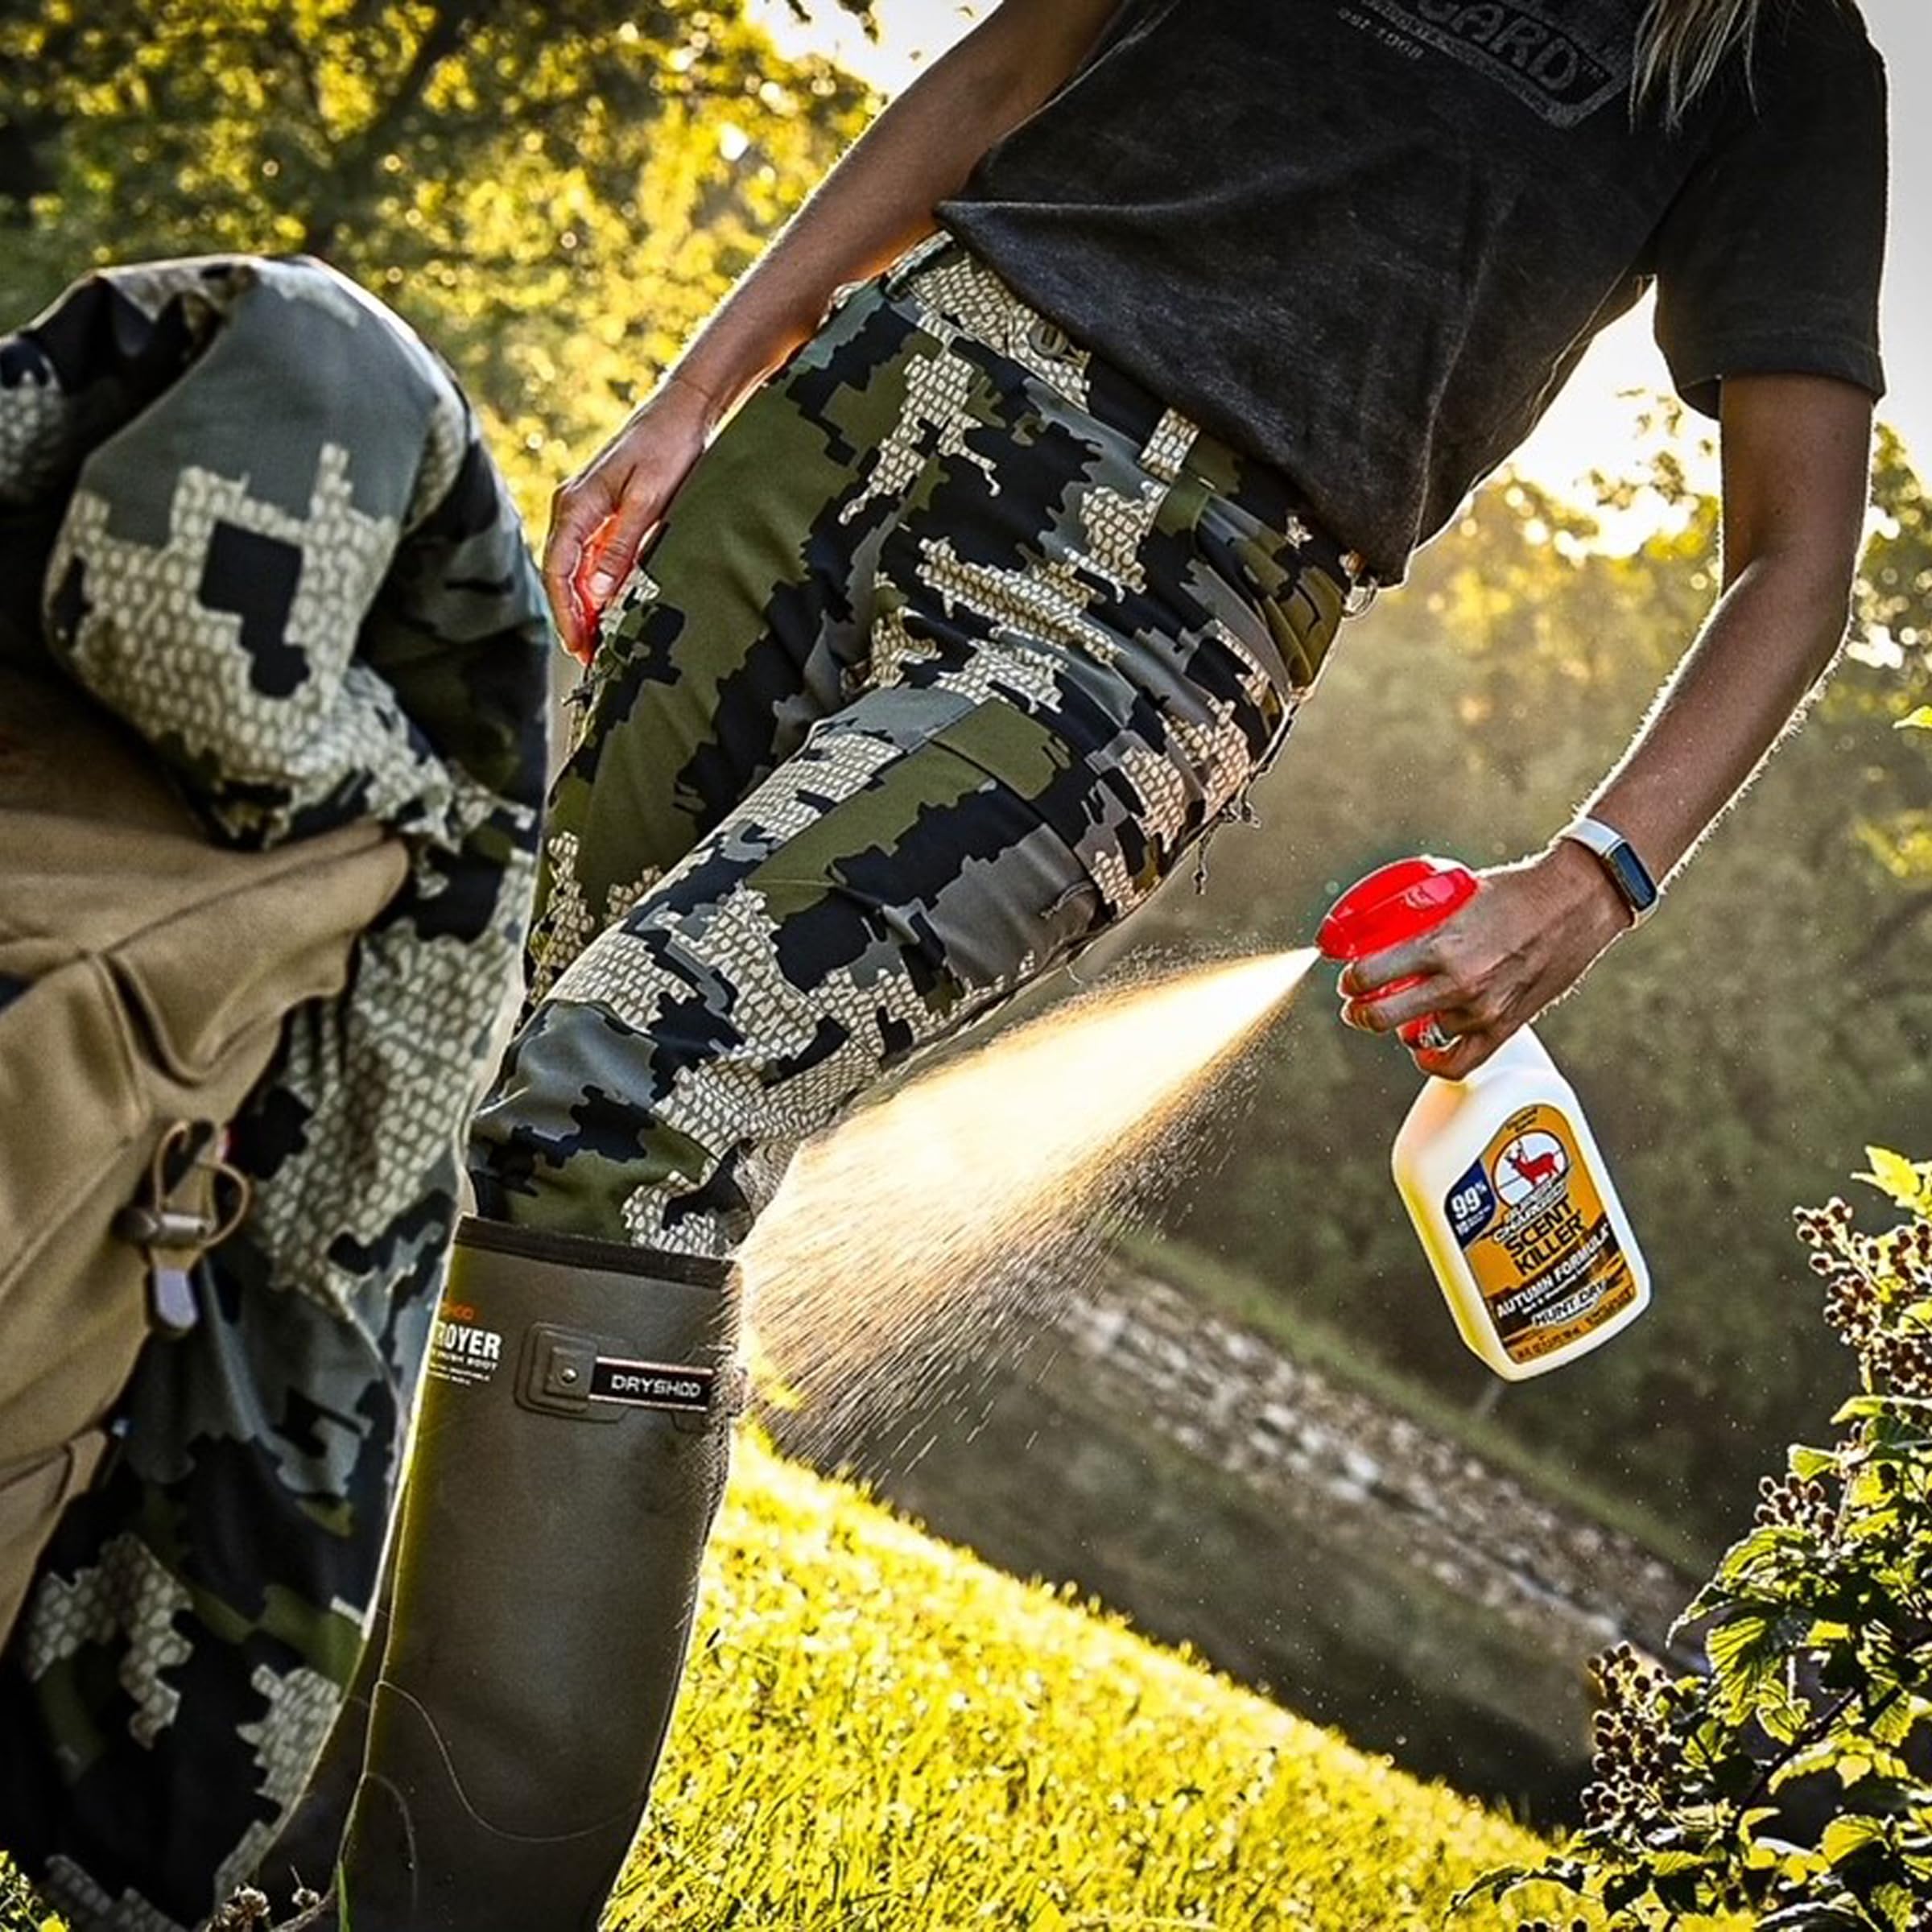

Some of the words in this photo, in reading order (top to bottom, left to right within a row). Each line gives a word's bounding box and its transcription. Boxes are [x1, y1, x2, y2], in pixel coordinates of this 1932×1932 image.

[1504, 1195, 1573, 1257] SCENT
[1513, 1212, 1585, 1276] KILLER
[1496, 1274, 1555, 1318] AUTUMN
[1554, 1224, 1609, 1282] FORMULA
[610, 1373, 701, 1398] DRYSHOD
